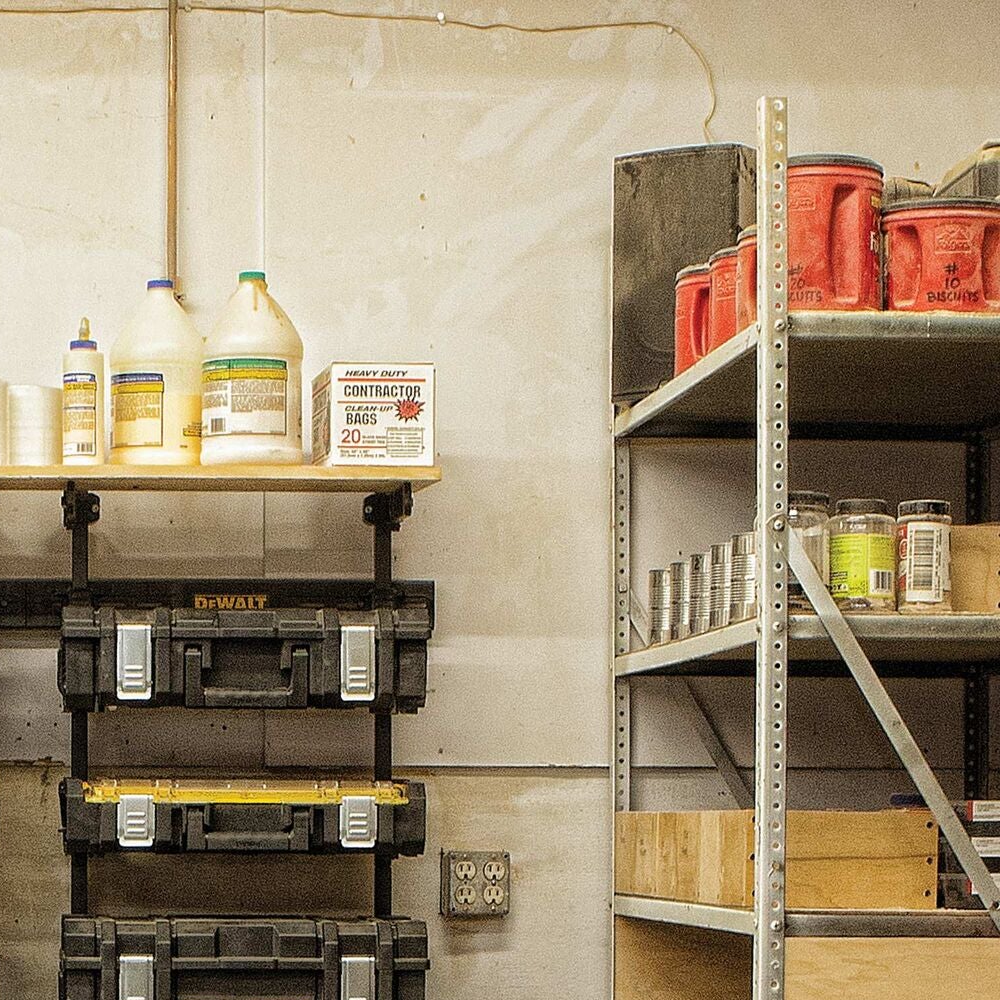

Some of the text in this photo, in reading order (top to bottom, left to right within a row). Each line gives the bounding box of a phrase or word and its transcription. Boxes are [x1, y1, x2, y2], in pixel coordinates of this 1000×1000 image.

[944, 278, 961, 289] 10
[788, 290, 823, 303] CUITS
[926, 291, 981, 303] BISCUITS
[344, 384, 421, 398] CONTRACTOR
[346, 412, 378, 425] BAGS
[341, 428, 361, 444] 20
